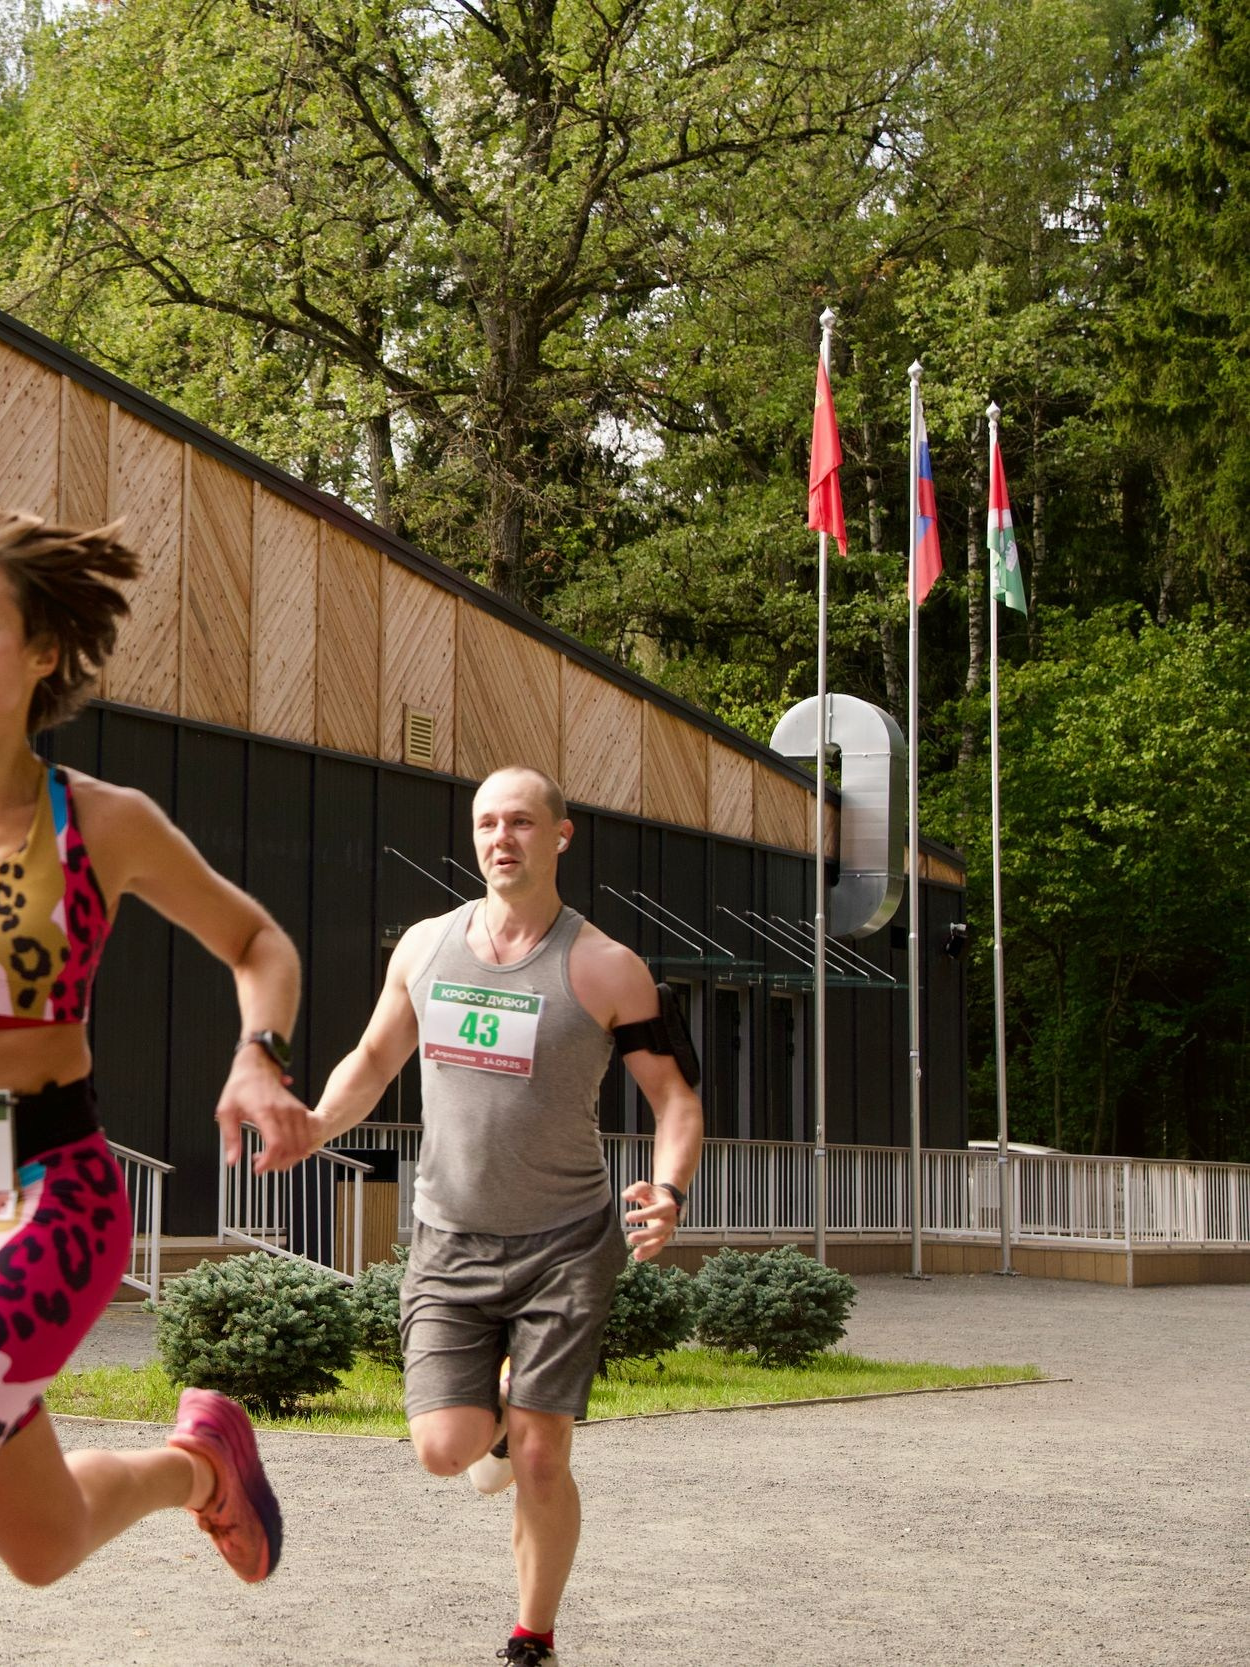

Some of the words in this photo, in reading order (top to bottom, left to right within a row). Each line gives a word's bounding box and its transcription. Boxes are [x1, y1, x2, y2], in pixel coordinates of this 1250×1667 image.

[441, 988, 485, 1003] КРОСС
[486, 995, 530, 1010] ДУБКИ
[458, 1011, 500, 1048] 43
